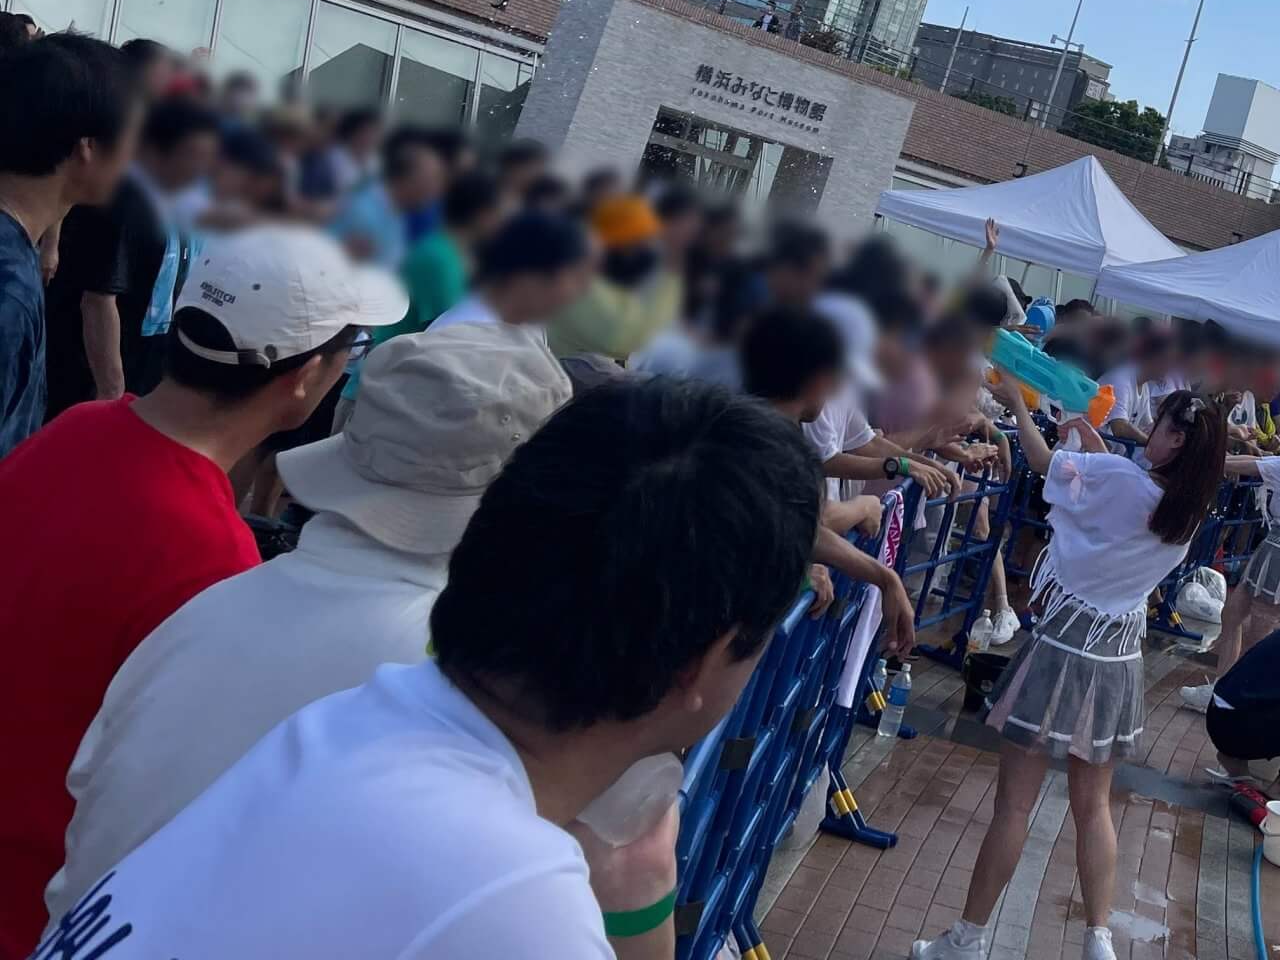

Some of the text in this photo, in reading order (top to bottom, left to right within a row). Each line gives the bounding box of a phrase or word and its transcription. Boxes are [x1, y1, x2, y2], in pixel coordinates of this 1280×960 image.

[695, 63, 827, 121] 横浜みなと博物館
